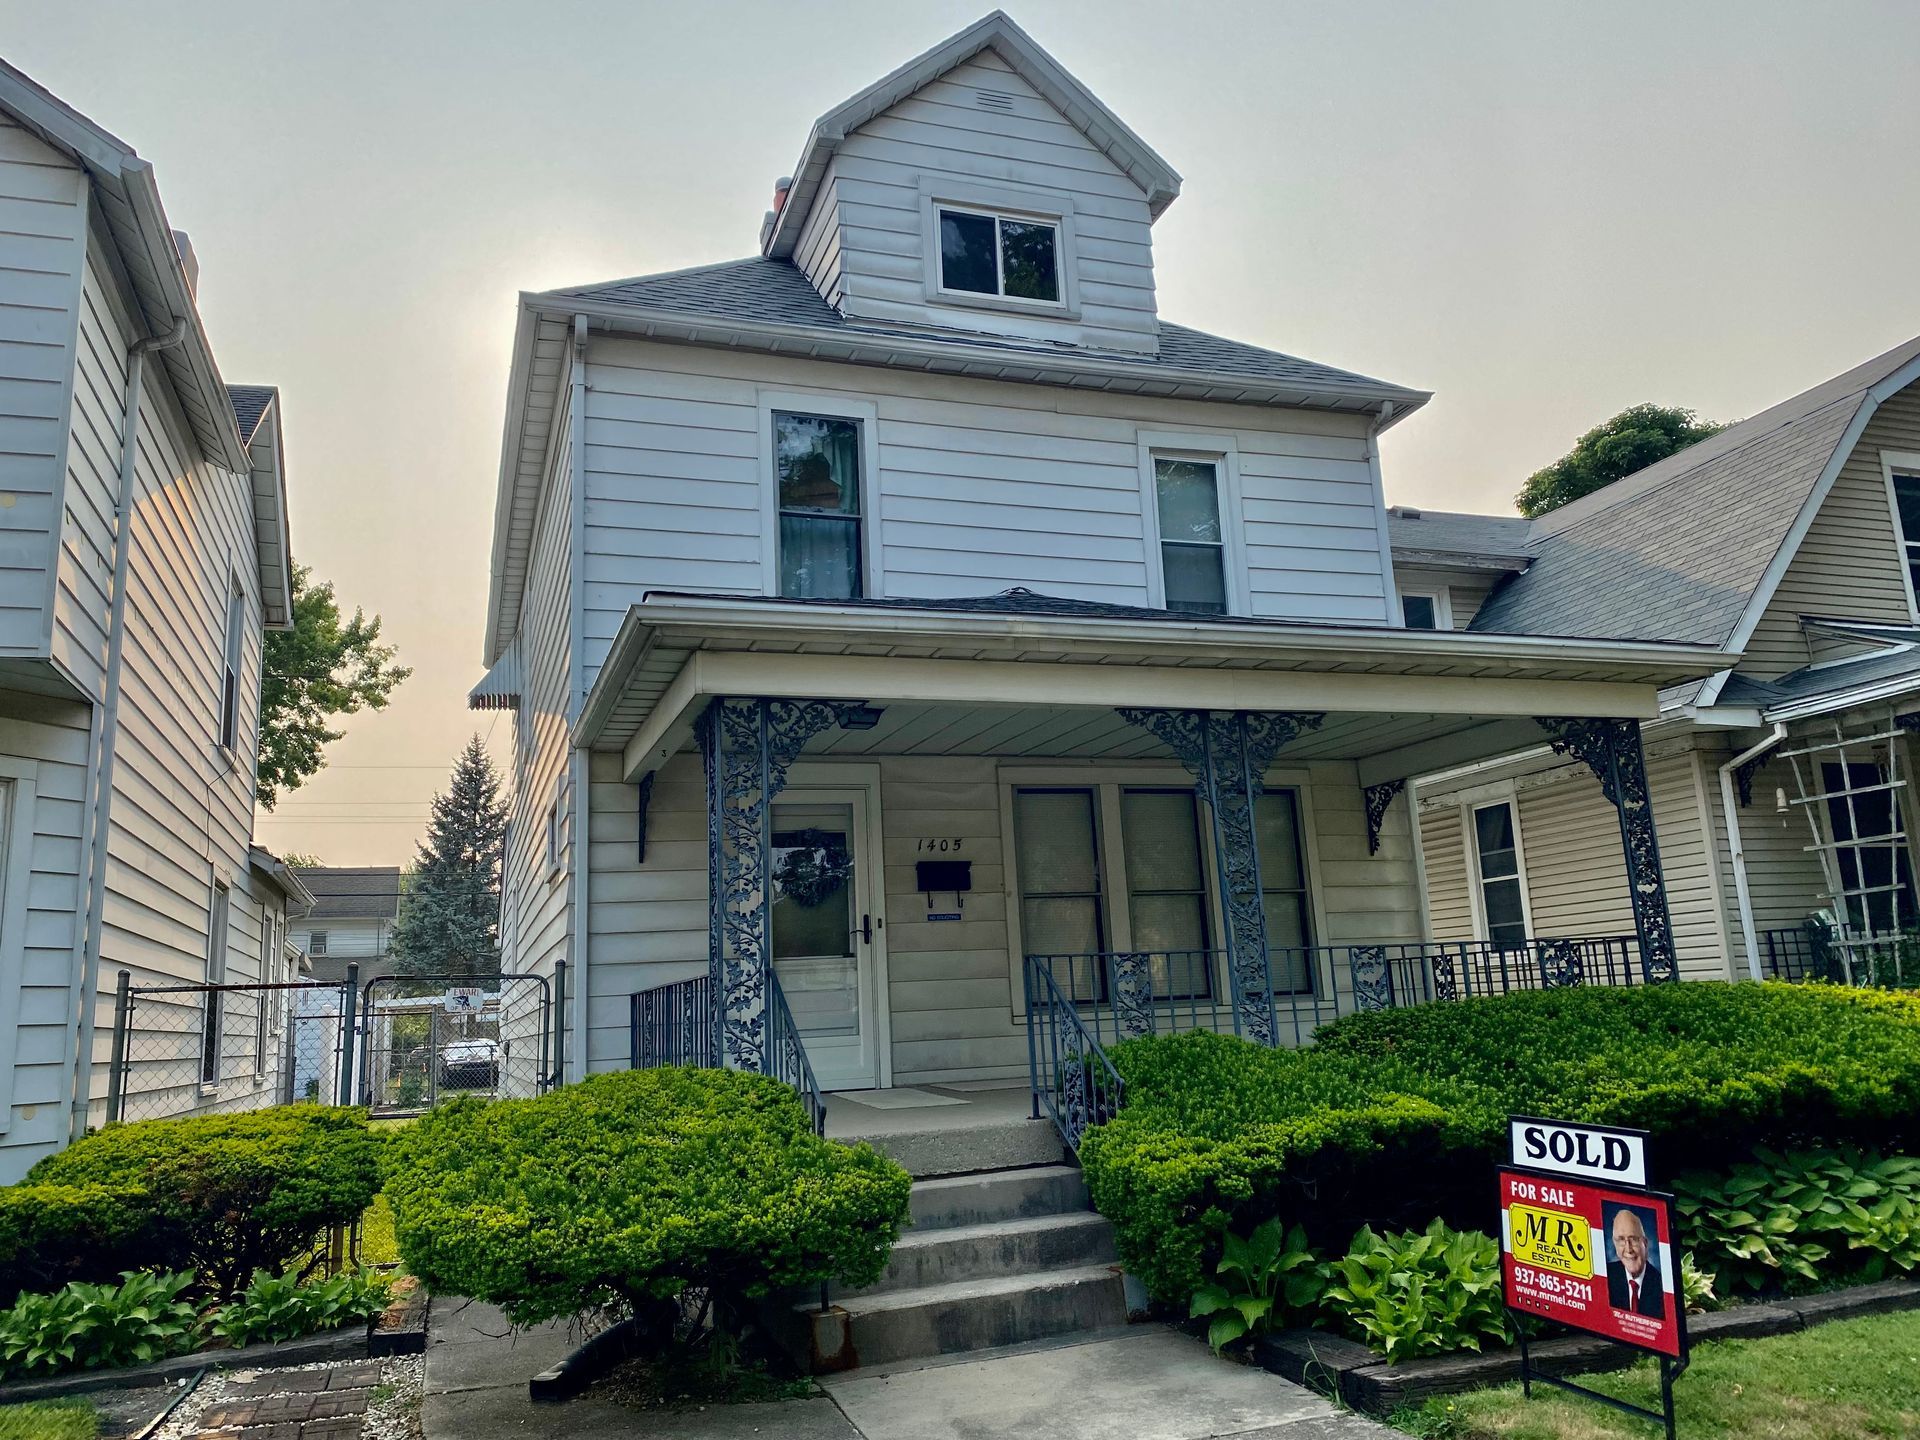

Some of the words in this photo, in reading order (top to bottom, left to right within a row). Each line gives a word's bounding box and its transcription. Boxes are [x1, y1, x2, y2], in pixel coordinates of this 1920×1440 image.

[917, 839, 962, 851] 1405
[1524, 1126, 1631, 1172] SOLD
[1511, 1180, 1537, 1200] FOR
[1541, 1186, 1575, 1208] SALE
[1531, 1252, 1572, 1269] ESTATE
[1536, 1243, 1565, 1257] REAL
[1514, 1266, 1593, 1302] 937-865-5211
[1515, 1284, 1586, 1311] www.mrmel.com
